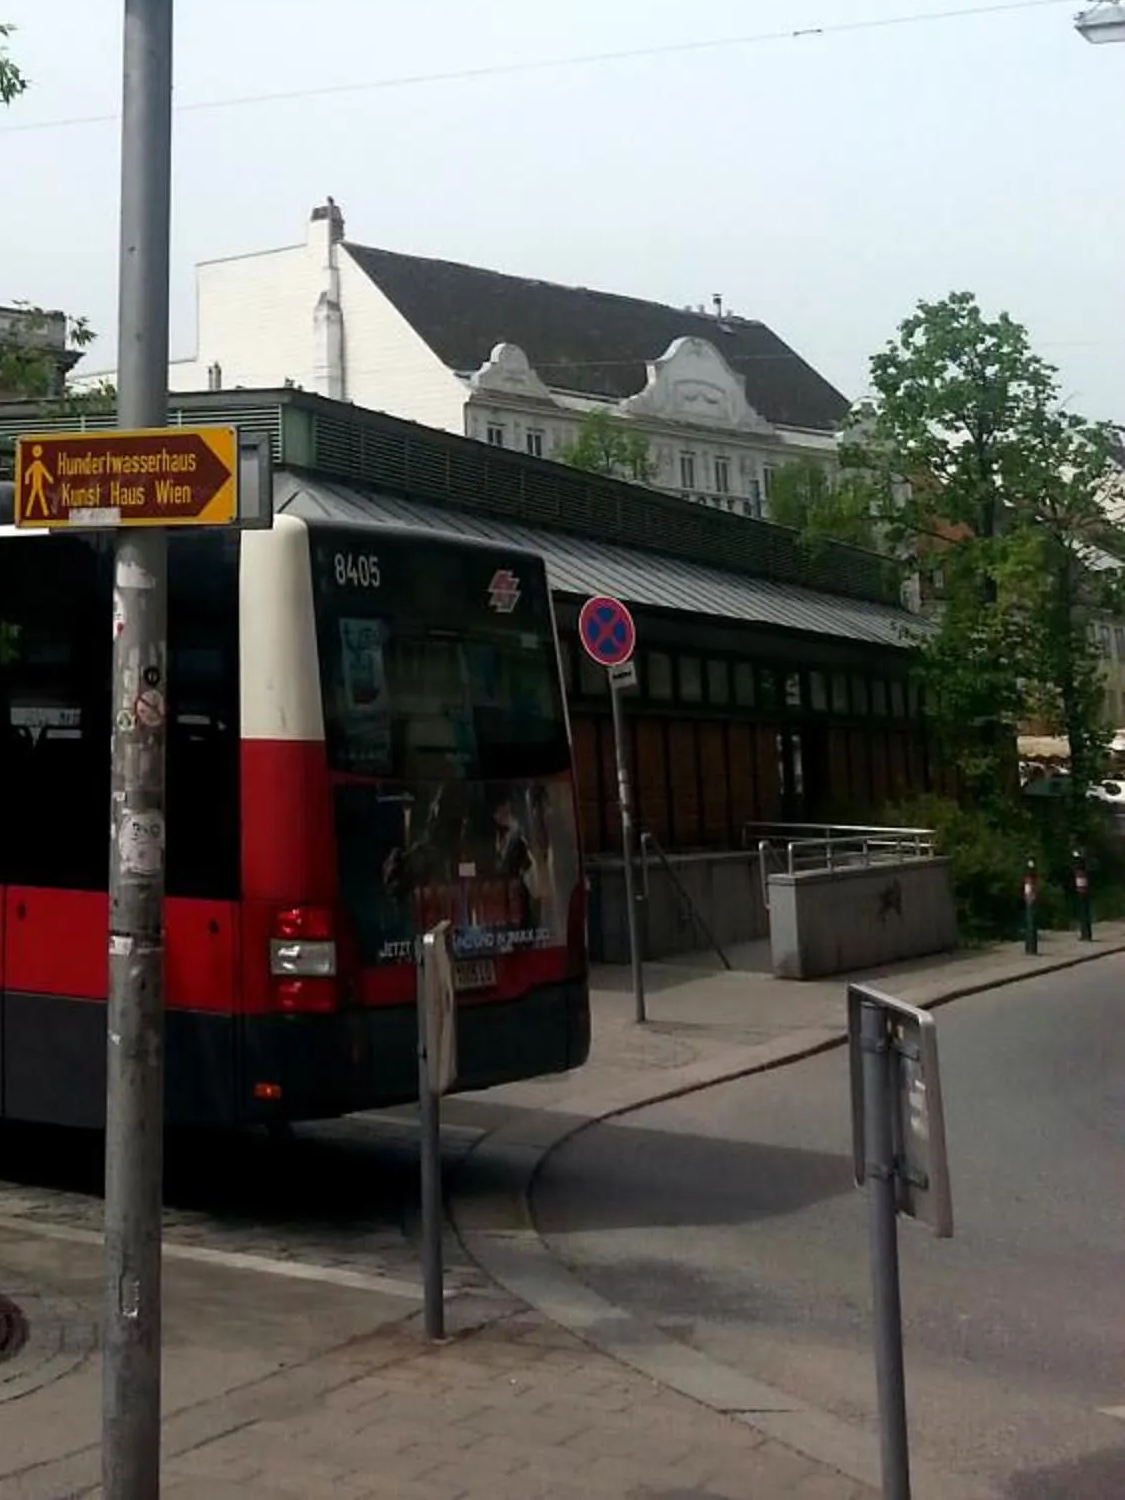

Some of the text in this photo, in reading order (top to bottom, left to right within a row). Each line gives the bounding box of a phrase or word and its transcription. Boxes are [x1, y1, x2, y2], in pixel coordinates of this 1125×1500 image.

[57, 448, 197, 476] Hundertwasserhaus
[61, 479, 192, 508] Kunst Haus Wien
[334, 552, 381, 589] 8405
